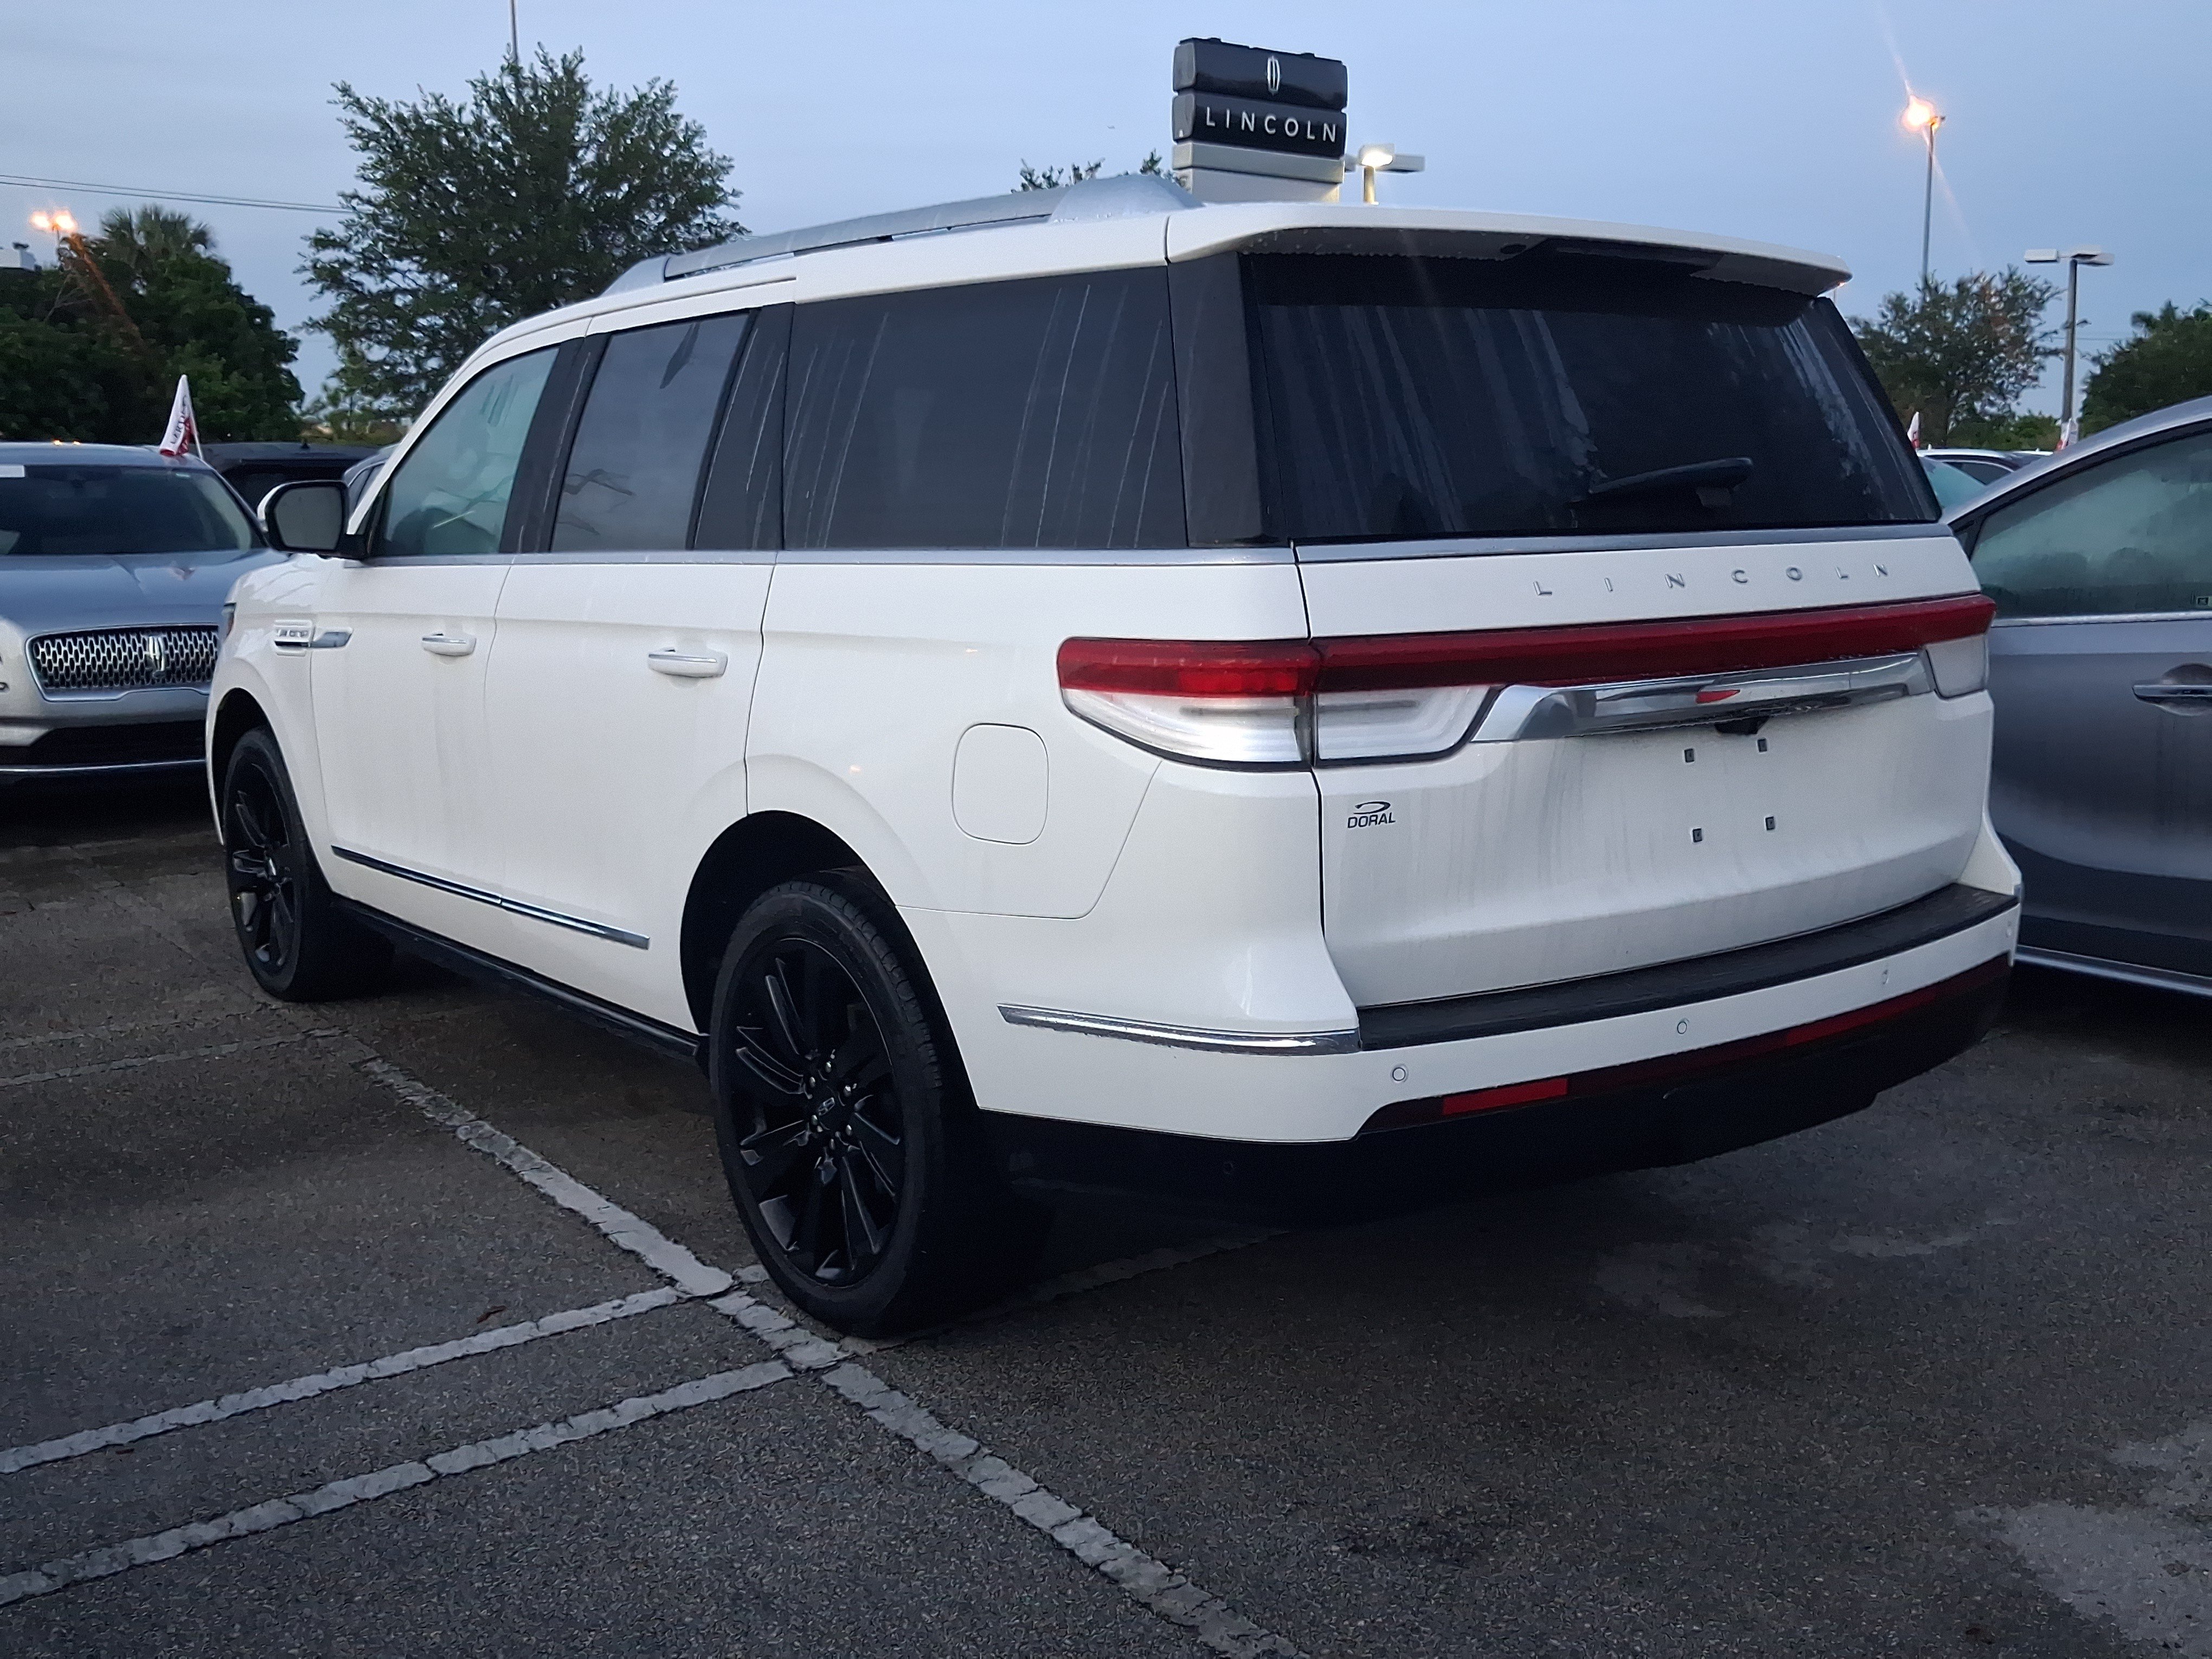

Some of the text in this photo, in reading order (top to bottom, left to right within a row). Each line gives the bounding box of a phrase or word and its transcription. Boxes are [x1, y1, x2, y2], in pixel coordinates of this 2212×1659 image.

[1206, 106, 1336, 143] LINCOLN
[1533, 563, 1888, 597] LINCOLN
[1347, 812, 1396, 828] DORAL
